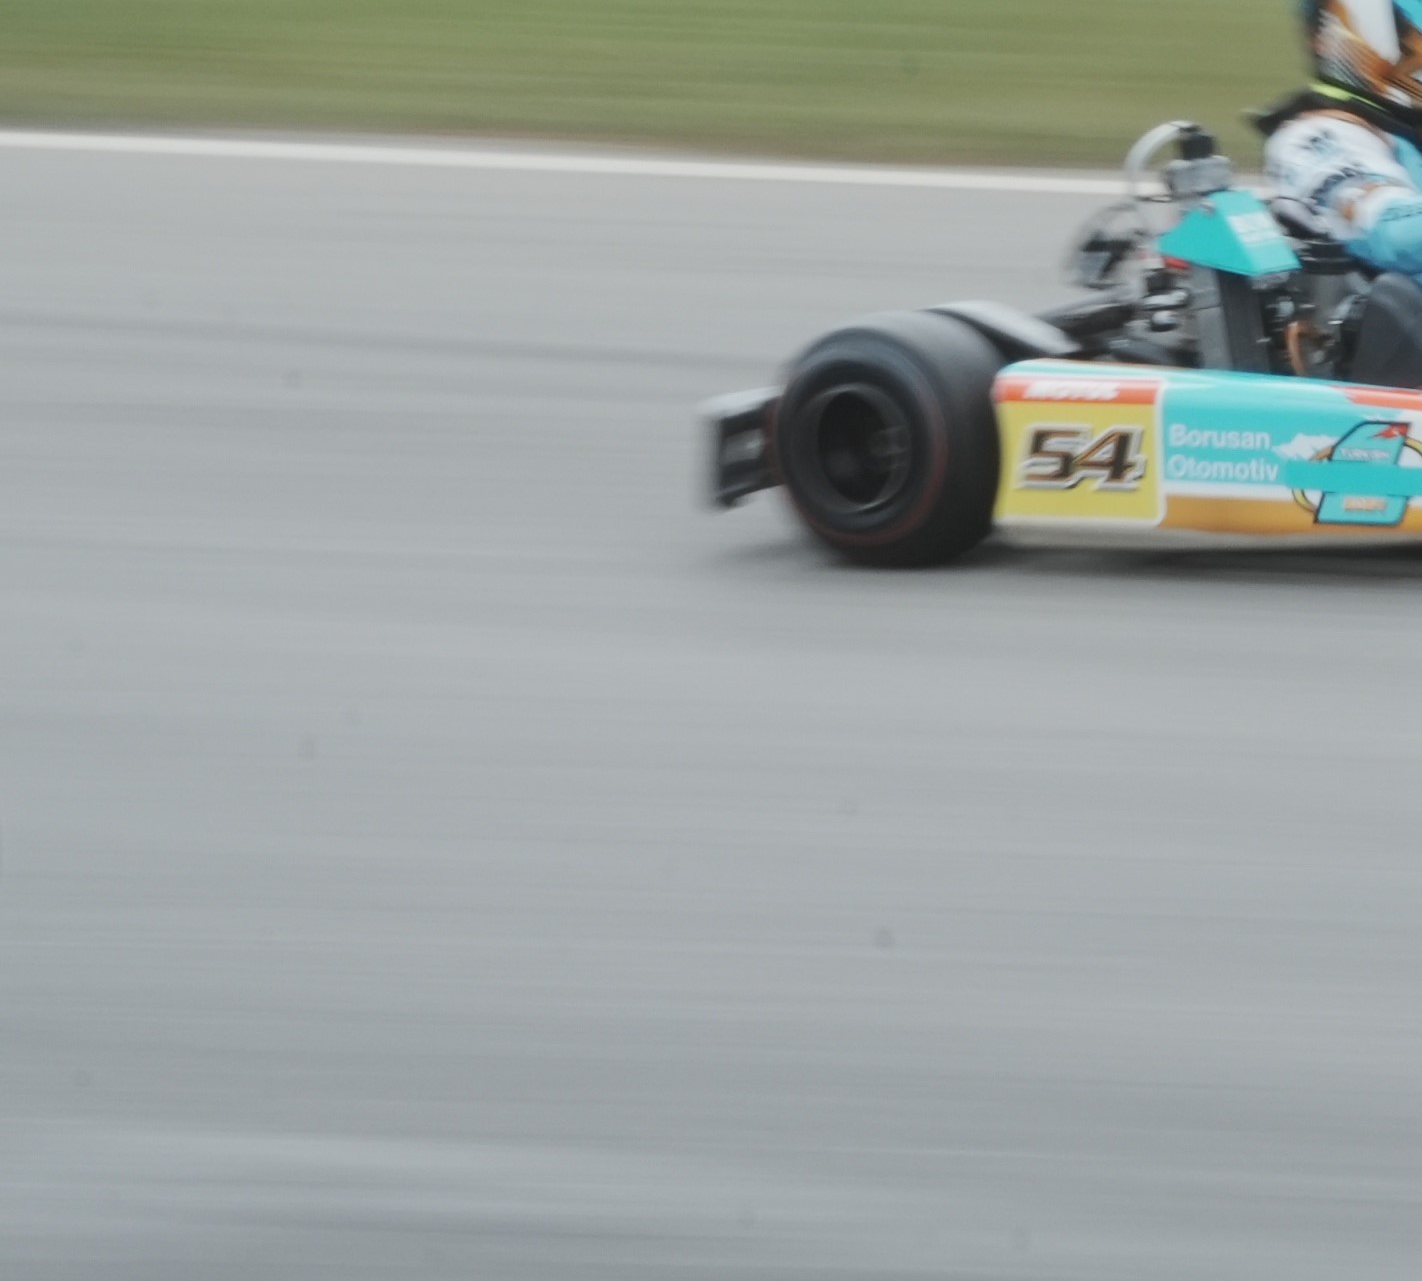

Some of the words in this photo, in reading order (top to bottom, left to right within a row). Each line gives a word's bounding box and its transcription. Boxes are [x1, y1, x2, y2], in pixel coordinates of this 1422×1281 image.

[1169, 423, 1271, 450] Borusan
[1017, 423, 1146, 490] 54
[1168, 454, 1279, 481] Otomotiv
